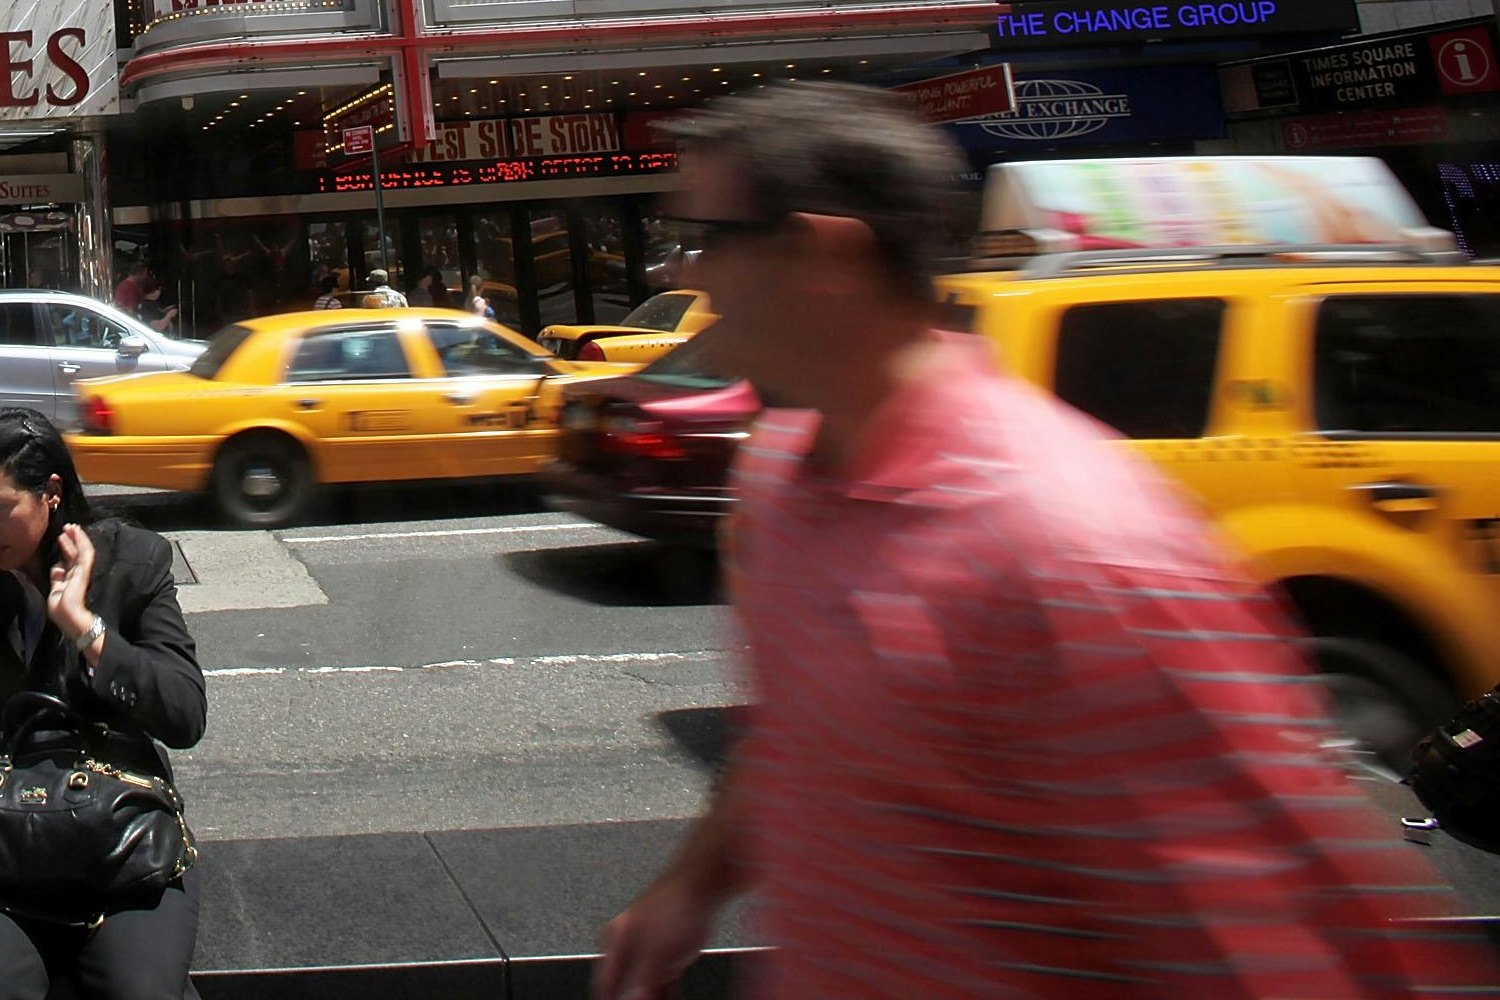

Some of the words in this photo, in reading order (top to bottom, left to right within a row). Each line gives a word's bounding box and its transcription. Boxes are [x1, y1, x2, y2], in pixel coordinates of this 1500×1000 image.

[997, 14, 1046, 37] THE
[1053, 7, 1171, 34] CHANGE
[1178, 0, 1277, 26] GROUP
[1303, 54, 1348, 73] TIMES
[1352, 44, 1416, 66] SQUARE
[1310, 62, 1417, 88] INFORMATION
[1336, 81, 1396, 102] CENTER
[1026, 94, 1131, 118] EXCHANGE
[478, 119, 542, 160] SIDE
[551, 113, 620, 155] STORY
